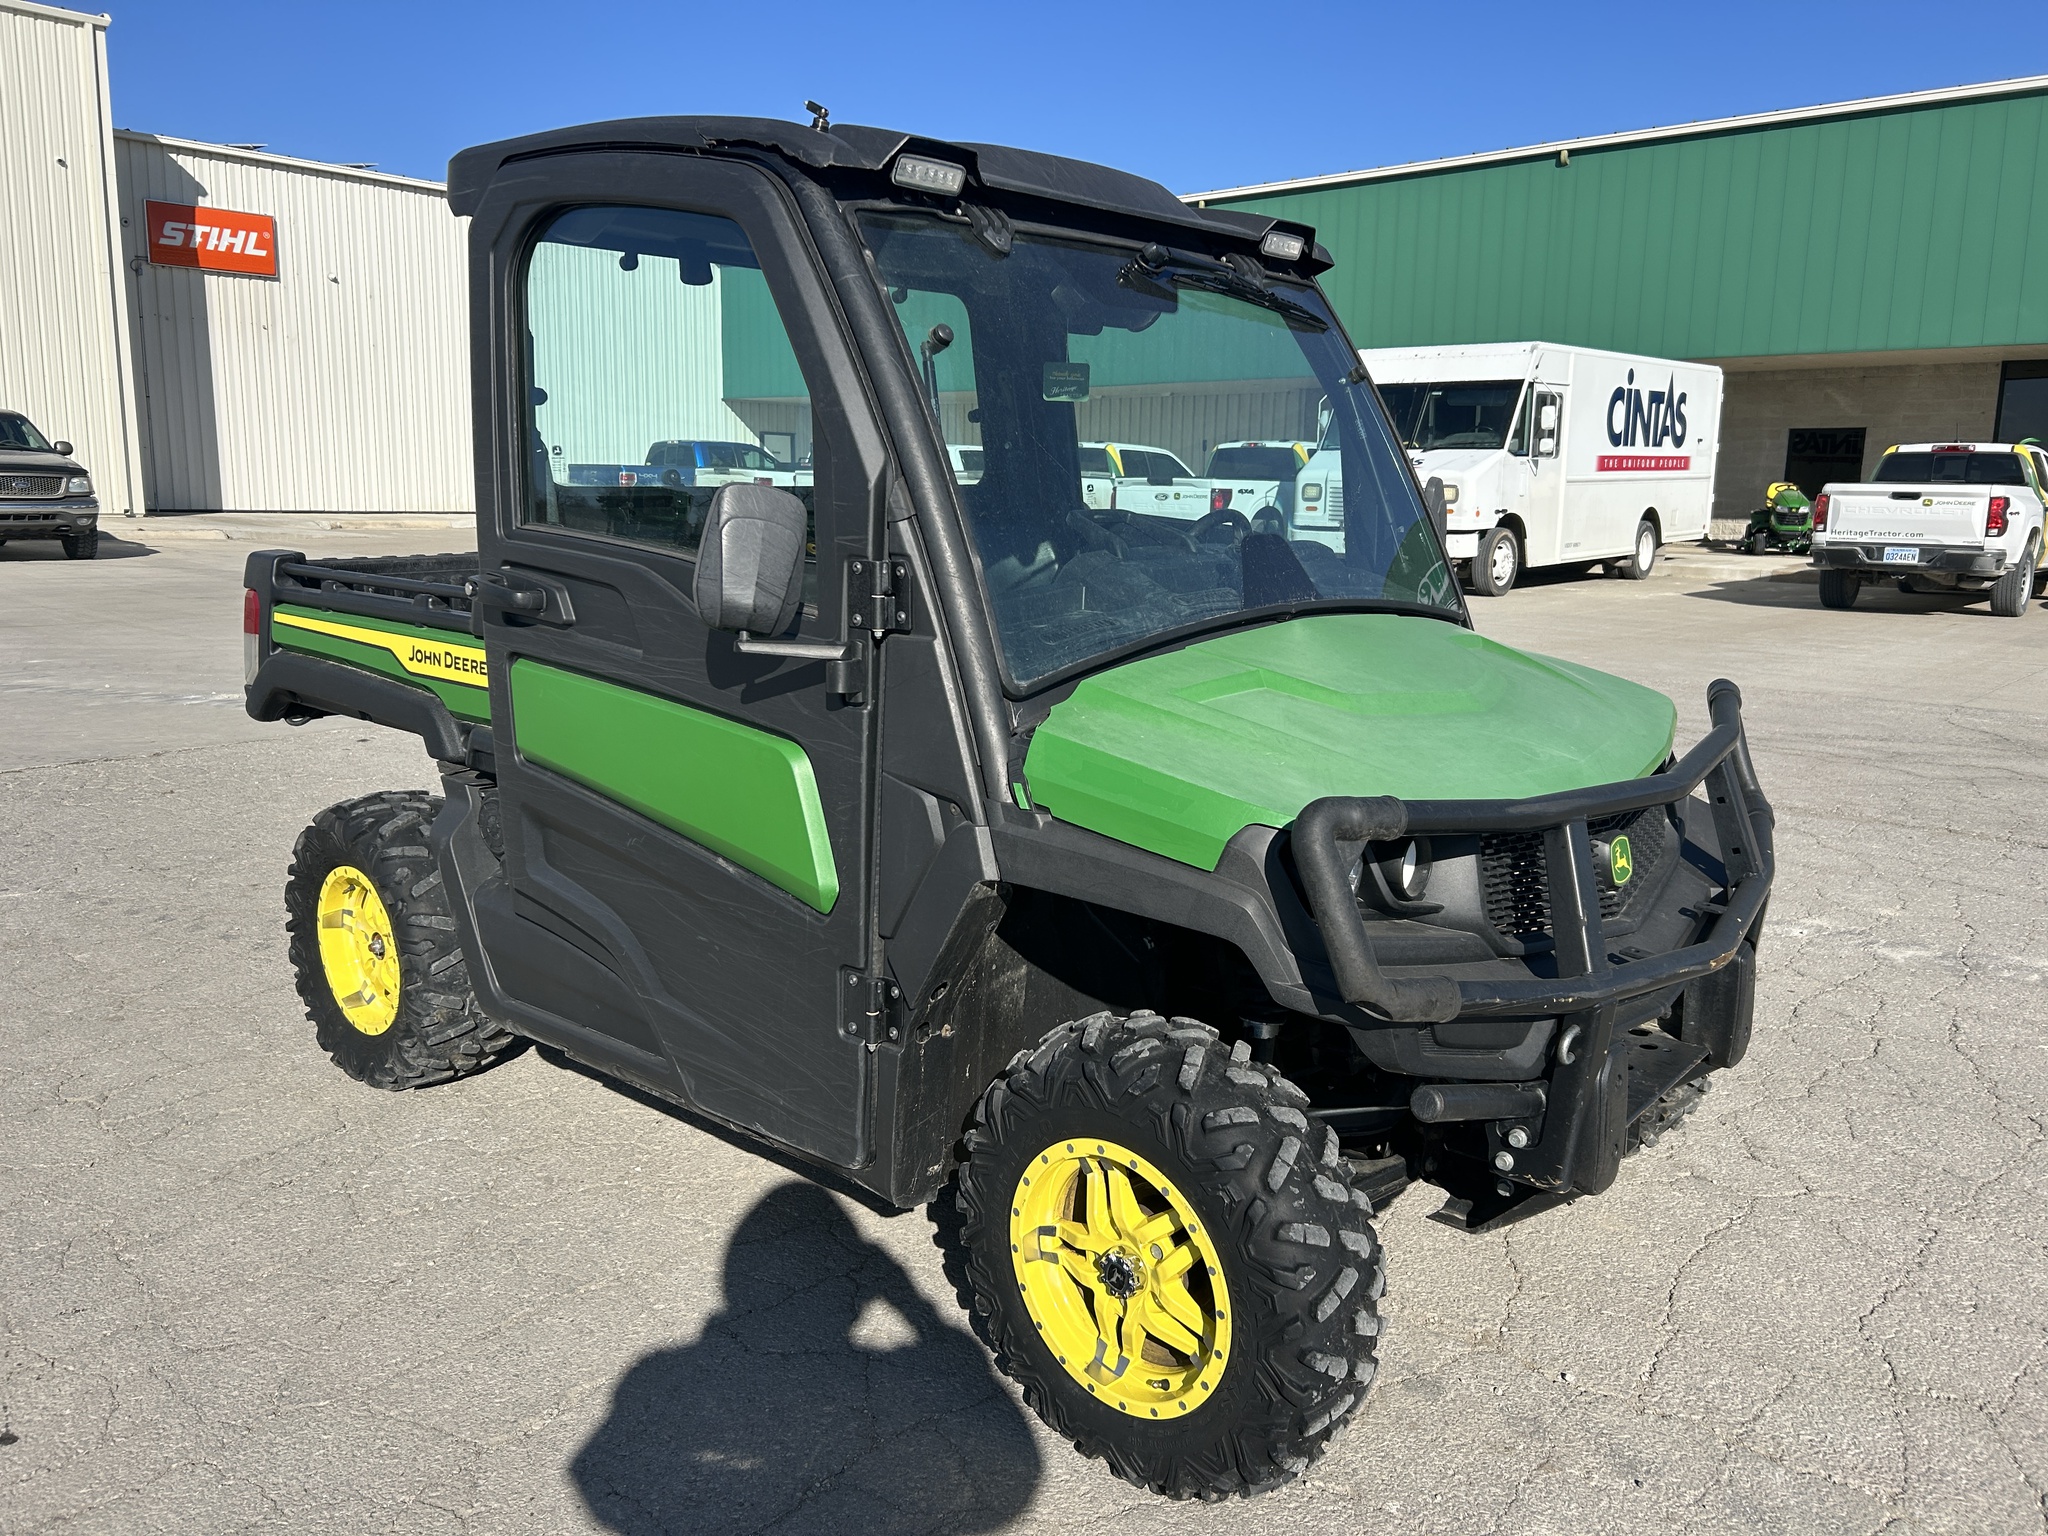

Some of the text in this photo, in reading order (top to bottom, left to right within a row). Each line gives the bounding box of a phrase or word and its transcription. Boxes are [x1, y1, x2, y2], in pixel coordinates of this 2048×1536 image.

[158, 221, 268, 257] STIHL
[1607, 367, 1687, 449] CINTAS
[1604, 458, 1685, 468] THE UNIFORM PEOPLE
[1830, 529, 1924, 538] HeritageTractor.com
[408, 645, 488, 676] JOHN DEERE
